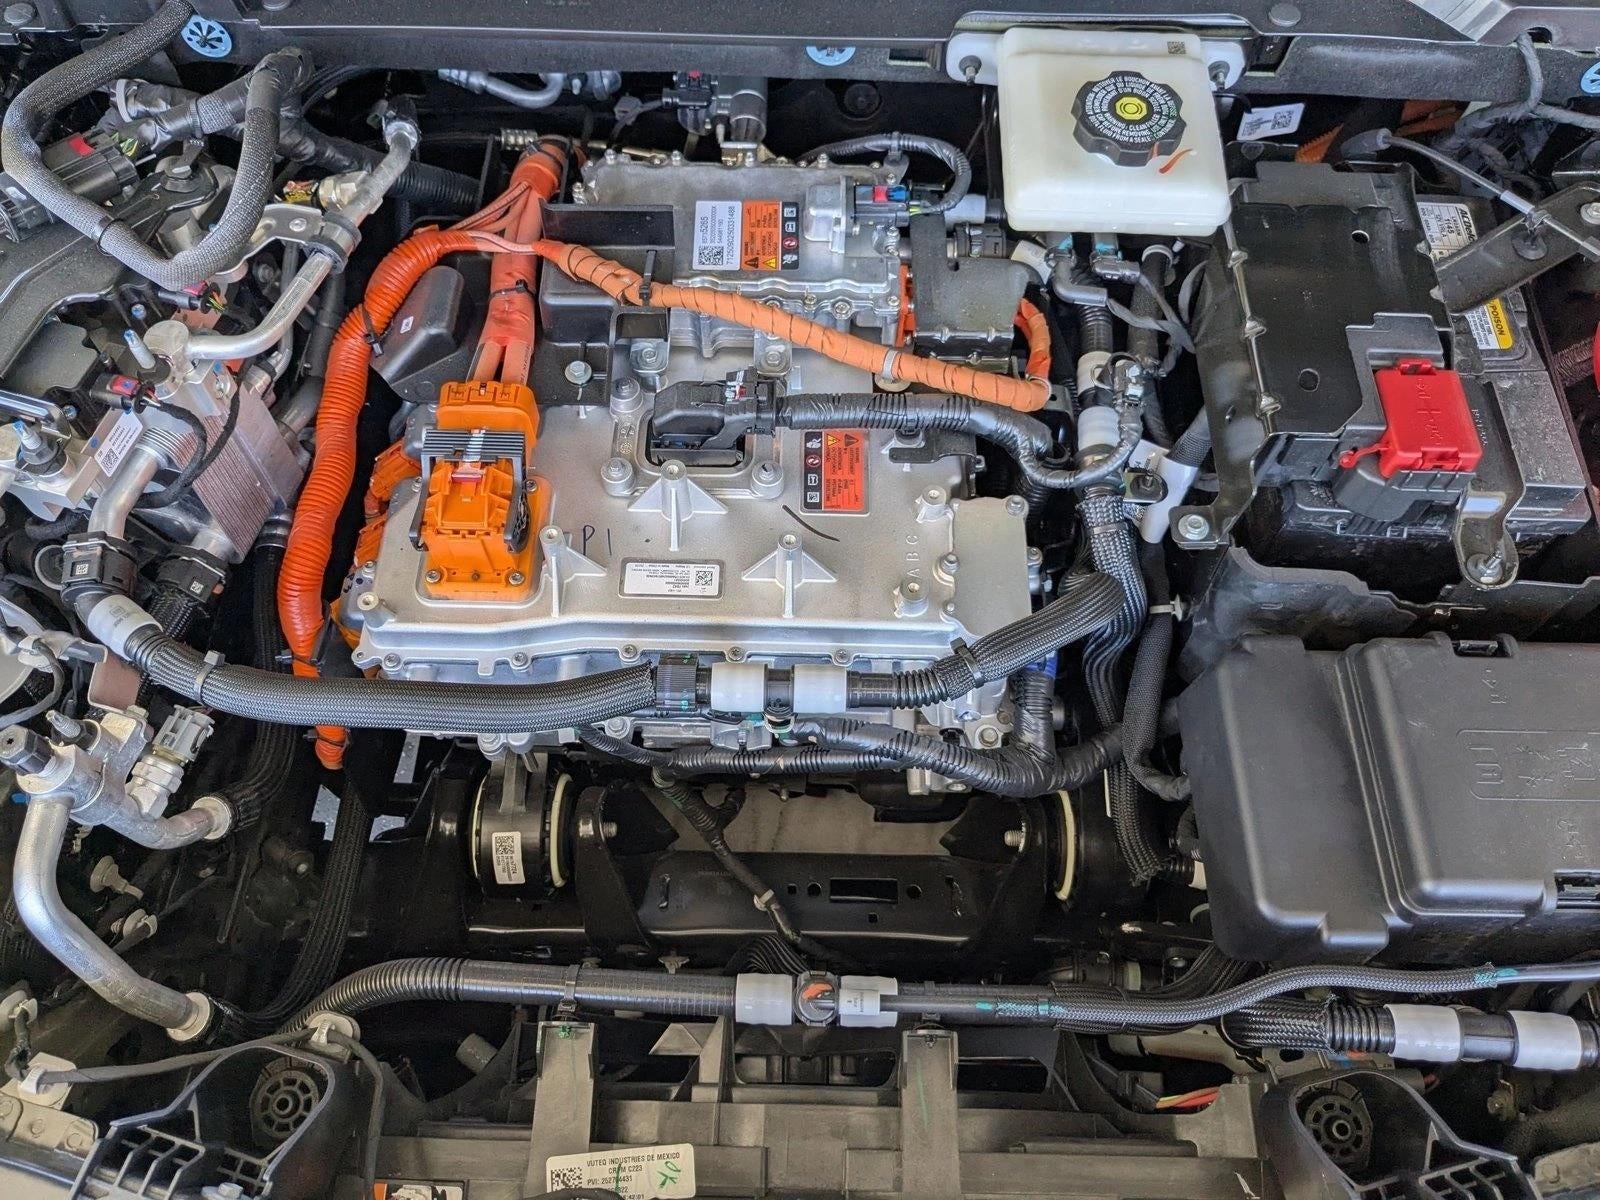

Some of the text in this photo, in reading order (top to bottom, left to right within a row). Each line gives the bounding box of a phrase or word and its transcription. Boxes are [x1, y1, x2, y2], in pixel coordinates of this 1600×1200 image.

[1103, 119, 1123, 134] BEFORE
[1129, 122, 1148, 130] CLEAN
[1458, 208, 1476, 243] ACDelc
[905, 535, 919, 545] C
[906, 551, 920, 561] B
[609, 1155, 645, 1165] INDUSTRIES
[646, 1154, 656, 1162] DE
[657, 1152, 681, 1160] MEXICO
[608, 1165, 643, 1174] CRM C223
